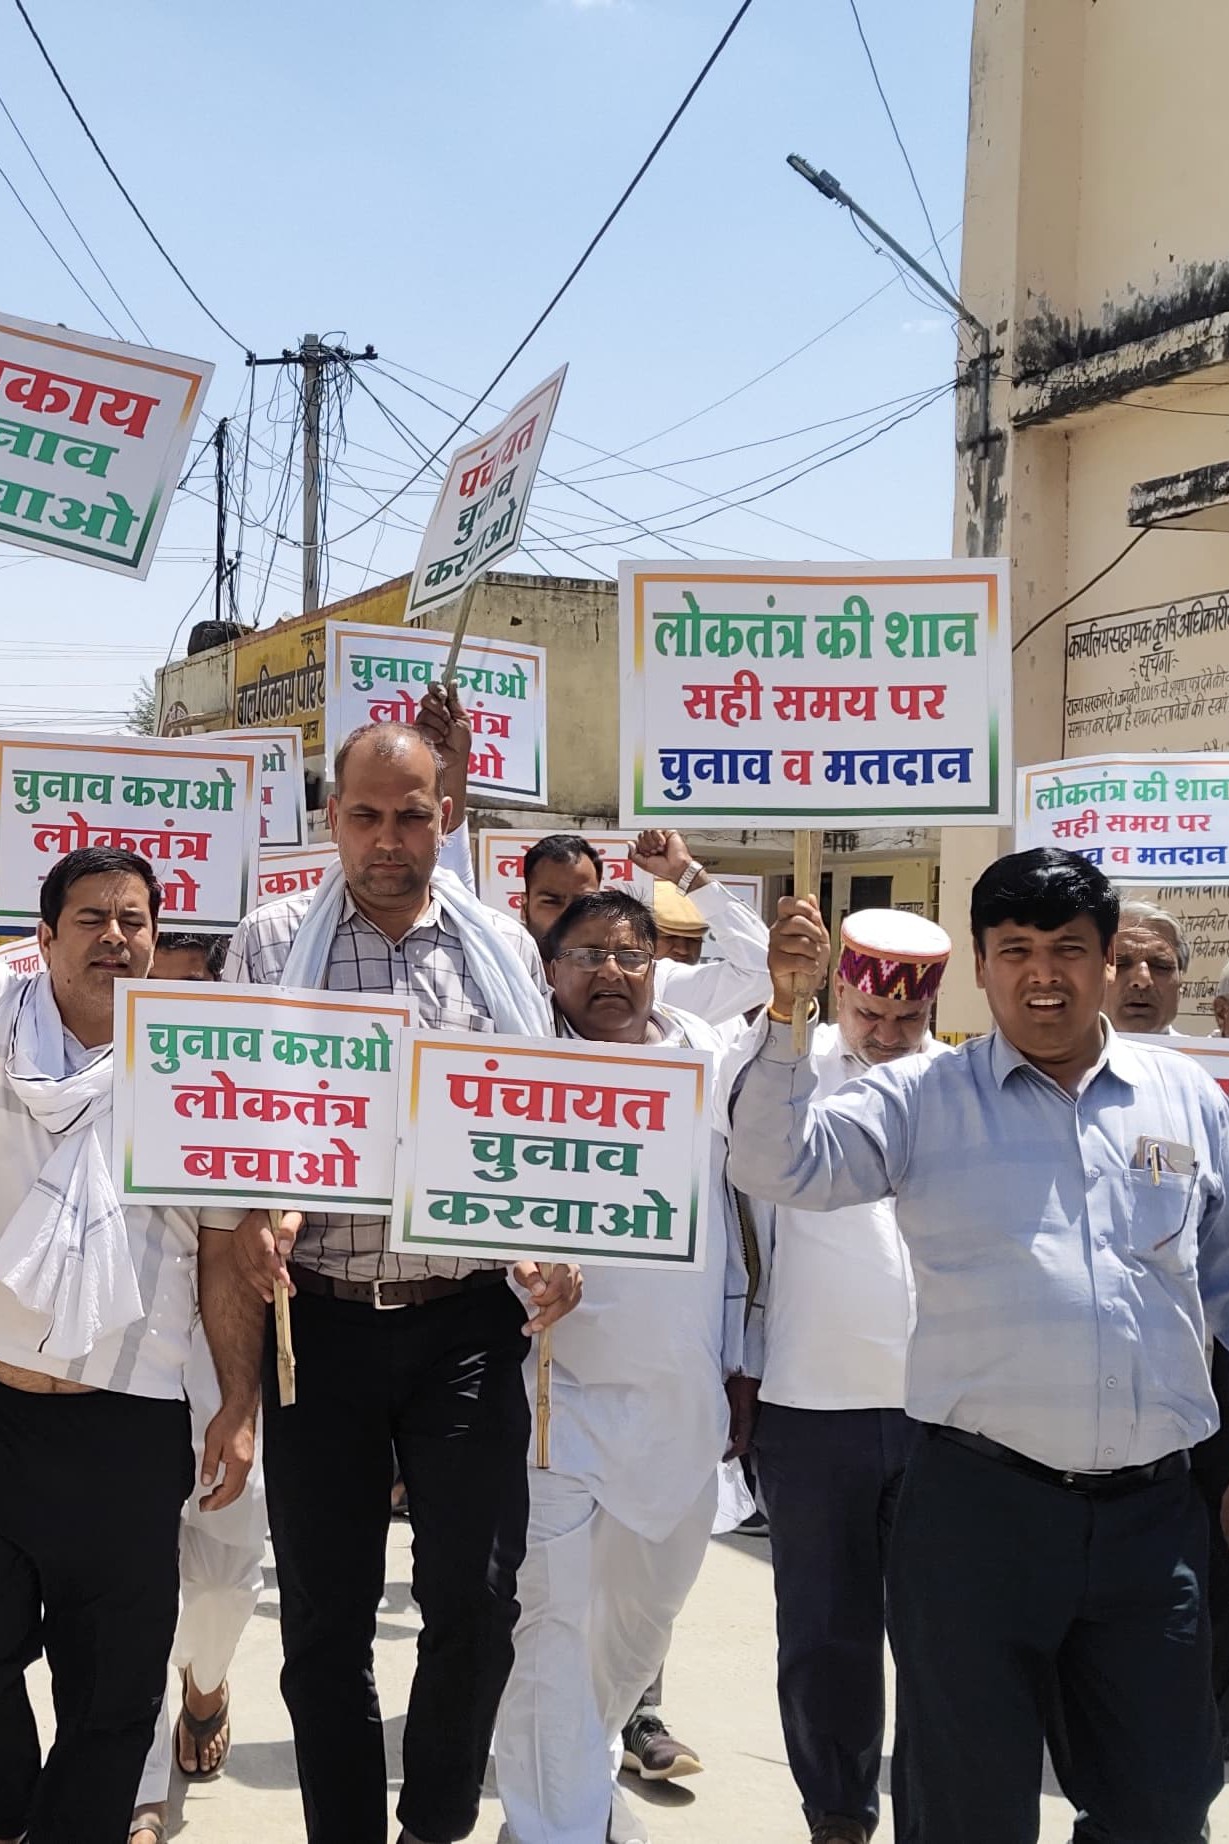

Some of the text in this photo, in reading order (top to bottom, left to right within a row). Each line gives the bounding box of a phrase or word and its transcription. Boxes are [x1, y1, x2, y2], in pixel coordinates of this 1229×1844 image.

[454, 465, 518, 546] चुनाव
[425, 497, 517, 587] करवाओ
[653, 591, 979, 658] लोकतंत्र की शान
[349, 654, 434, 692] चुनाव
[682, 669, 947, 727] सही समय पर
[12, 769, 115, 814] चुनाव
[122, 768, 236, 811] कराओ
[658, 748, 973, 801] चुनाव व मतदान
[1036, 771, 1127, 810] लोकतंत्र
[1133, 771, 1169, 802] की
[32, 812, 212, 861] लोकतंत्र
[1052, 809, 1211, 838] सही समय पर
[1112, 848, 1131, 864] व
[1137, 846, 1226, 866] मतदान
[146, 1022, 393, 1074] चुनाव कराओ
[171, 1070, 370, 1129] लोकतंत्र
[446, 1058, 670, 1132] पंचायत
[181, 1137, 361, 1187] बचाओ
[468, 1130, 643, 1183] चुनाव
[426, 1188, 678, 1241] करवाओ
